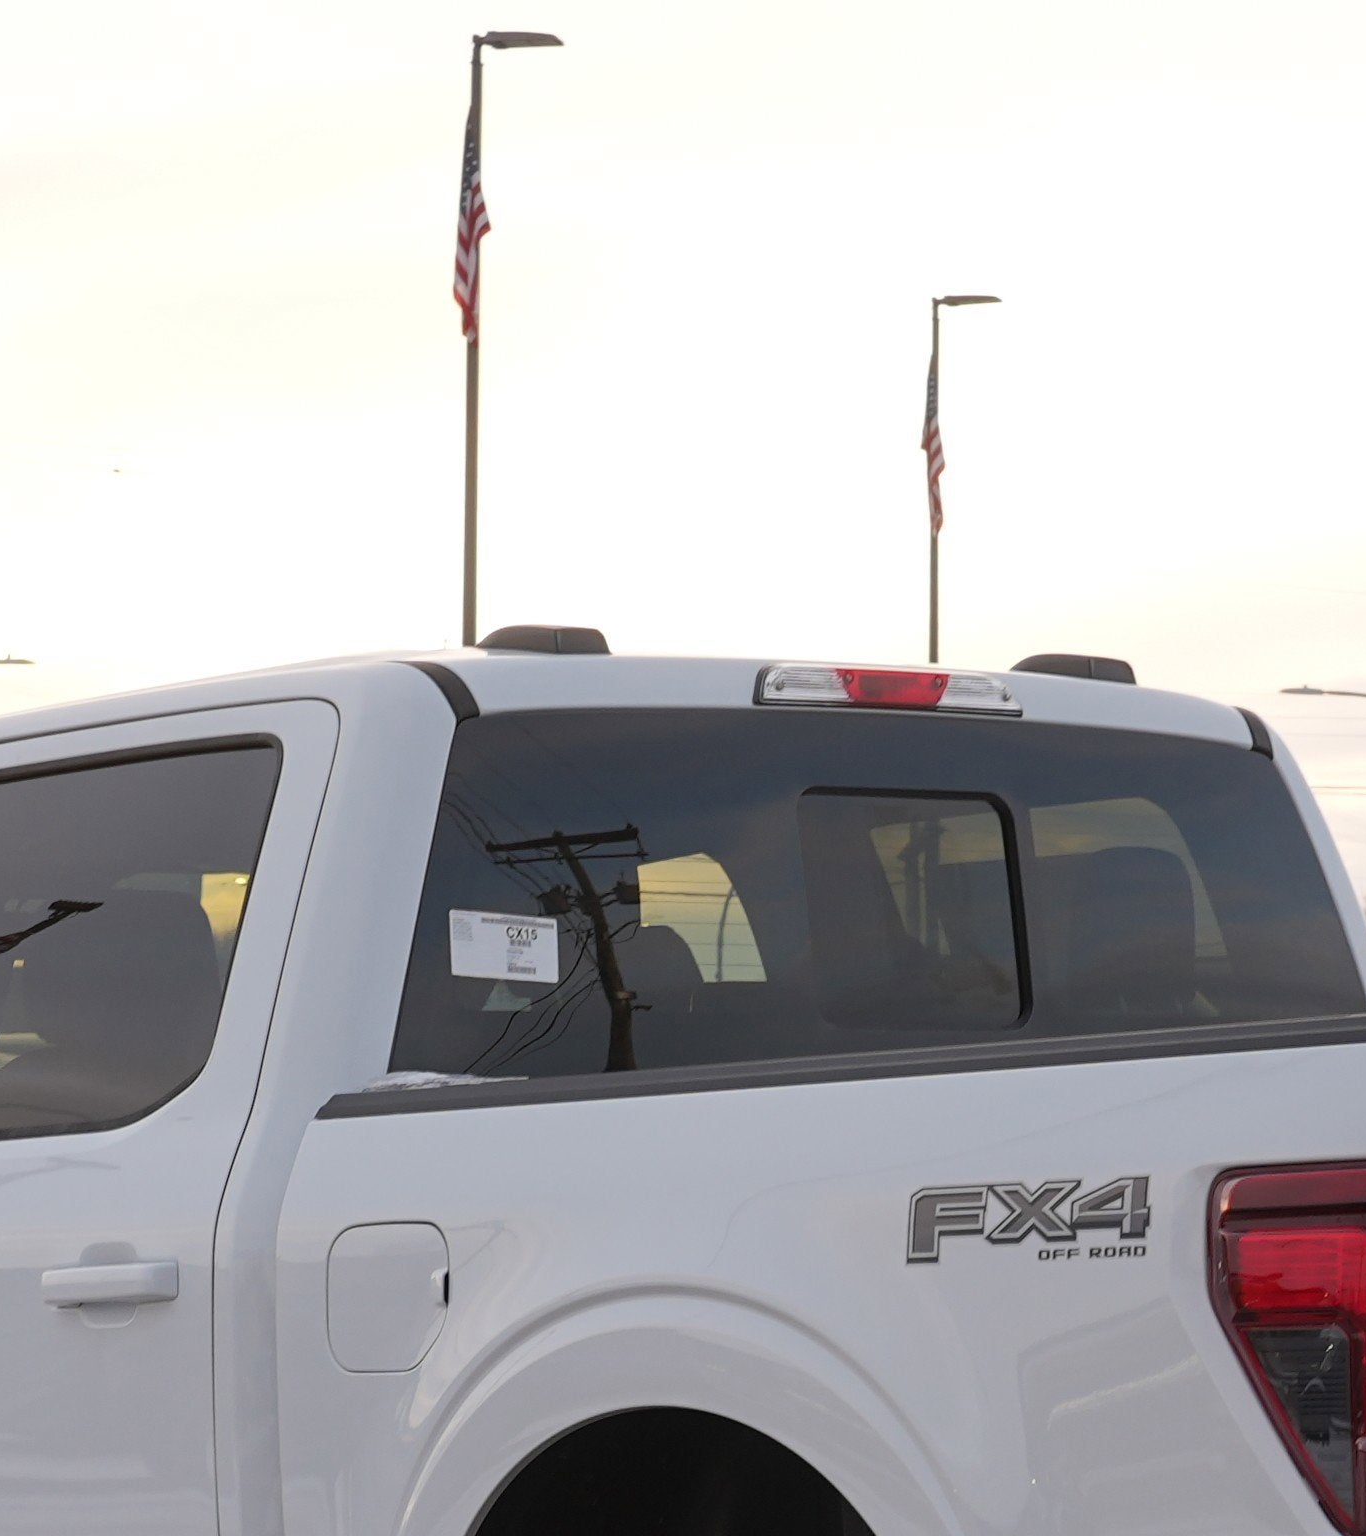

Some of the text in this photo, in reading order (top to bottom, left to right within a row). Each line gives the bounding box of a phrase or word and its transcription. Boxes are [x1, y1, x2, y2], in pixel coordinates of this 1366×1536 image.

[506, 926, 538, 941] CX15
[906, 1175, 1150, 1265] FX4
[1037, 1245, 1147, 1261] OFF ROAD
